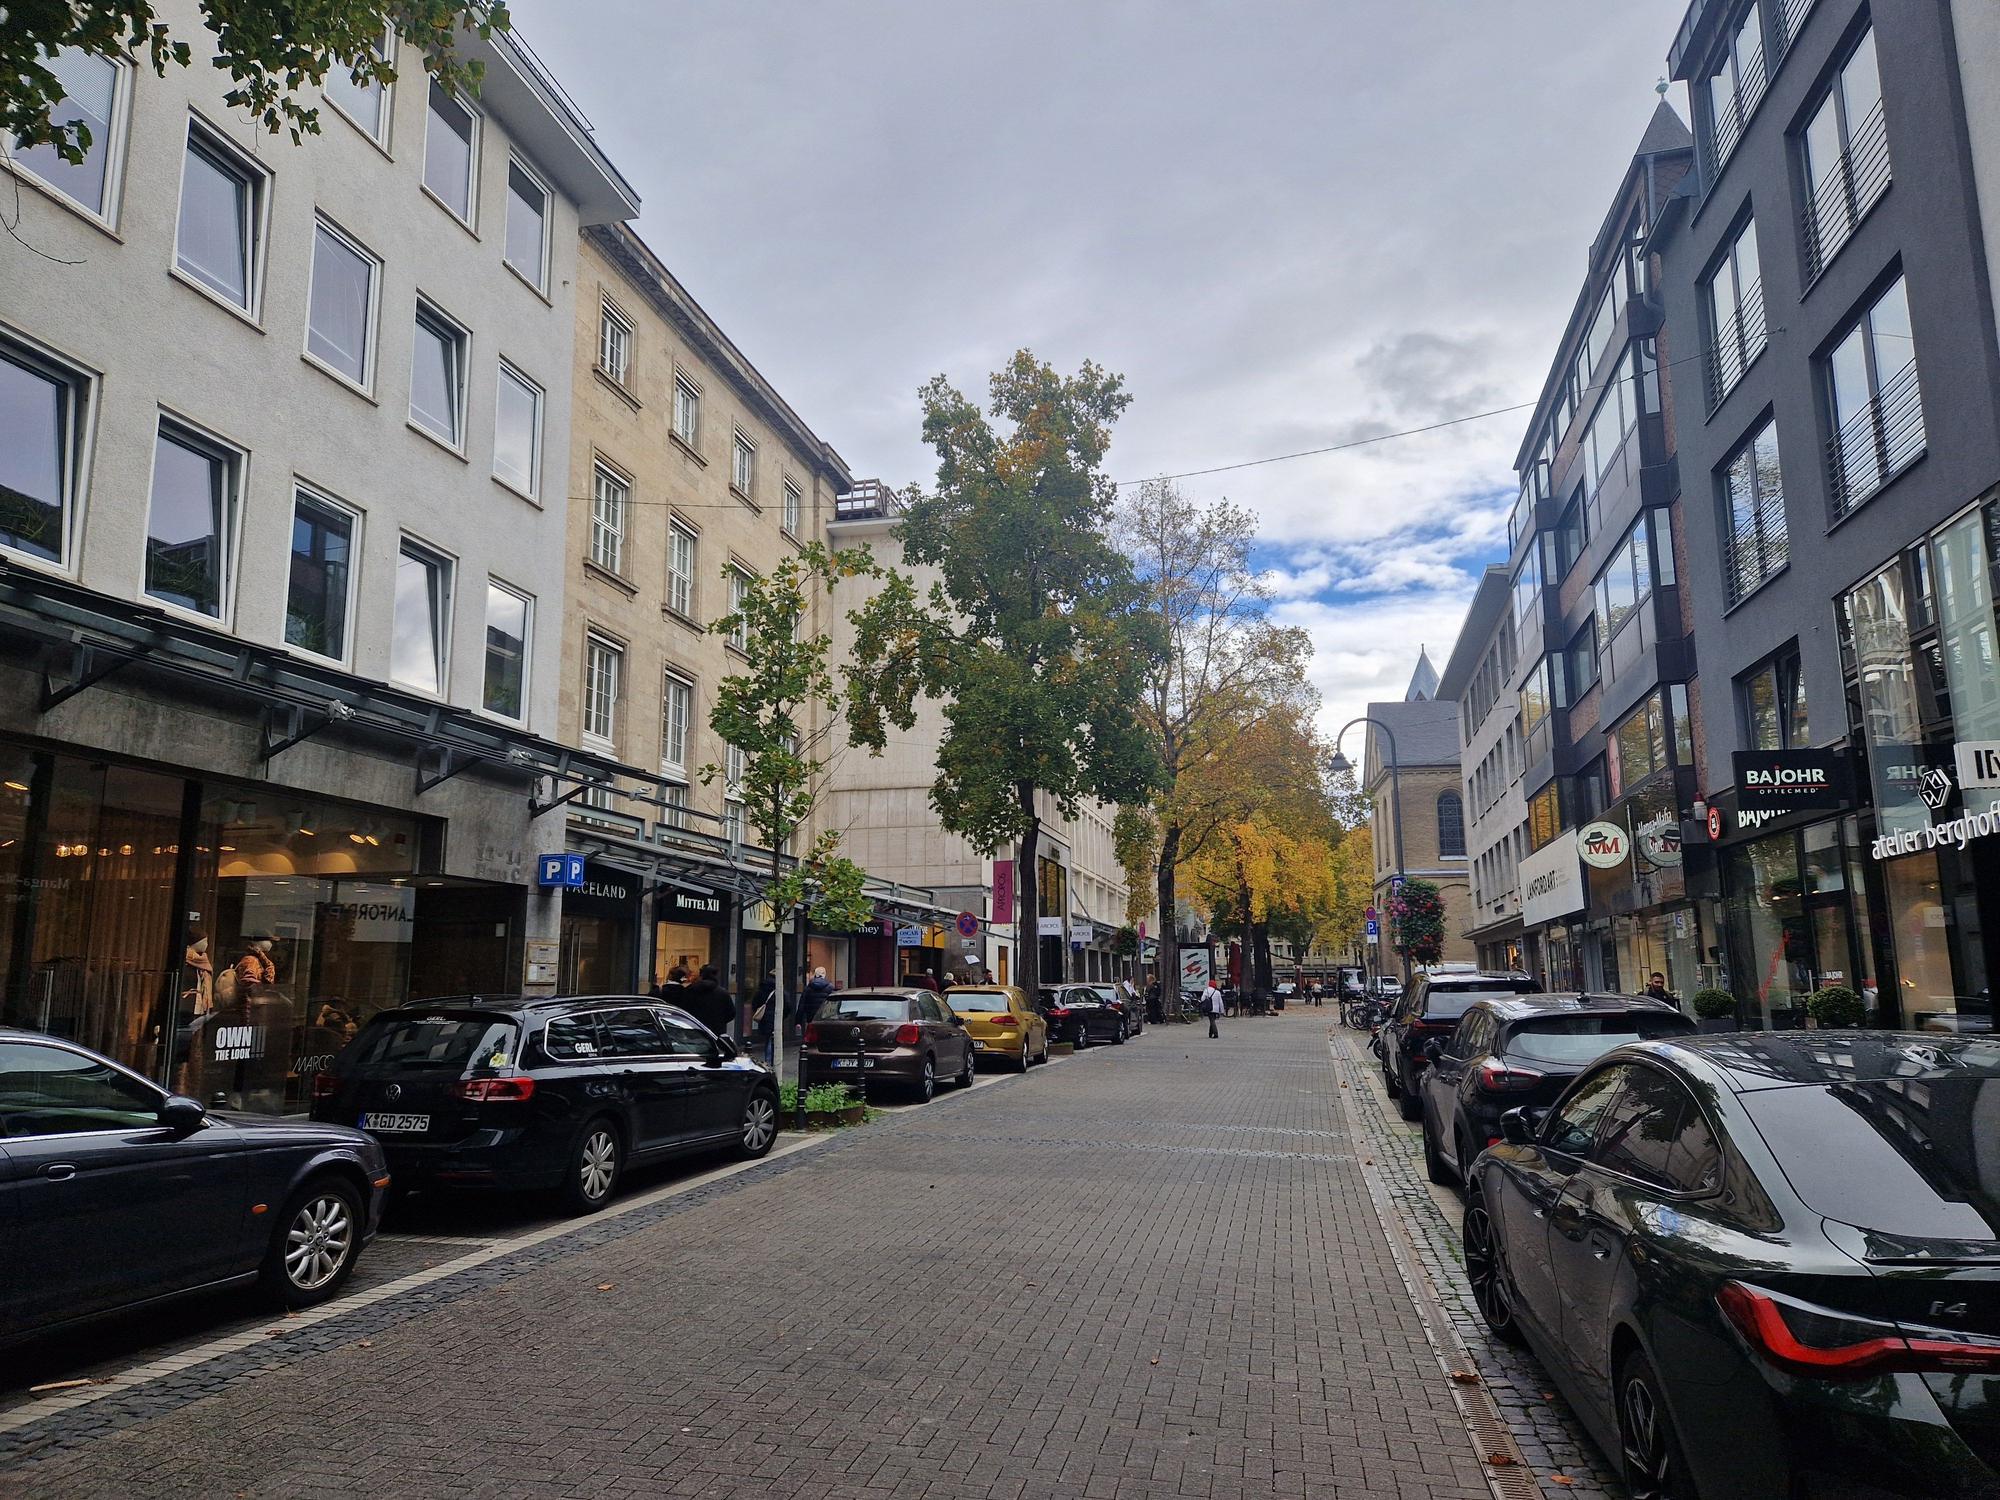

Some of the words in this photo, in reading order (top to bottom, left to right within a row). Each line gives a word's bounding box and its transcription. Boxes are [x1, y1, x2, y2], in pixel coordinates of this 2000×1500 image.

[1872, 827, 1922, 860] atelier
[546, 861, 561, 880] P
[571, 863, 580, 880] P
[706, 898, 720, 912] XII
[215, 1049, 230, 1061] THE
[230, 1047, 251, 1060] LOOK
[364, 1113, 373, 1127] K
[379, 1114, 395, 1129] GD
[396, 1115, 429, 1131] 2575
